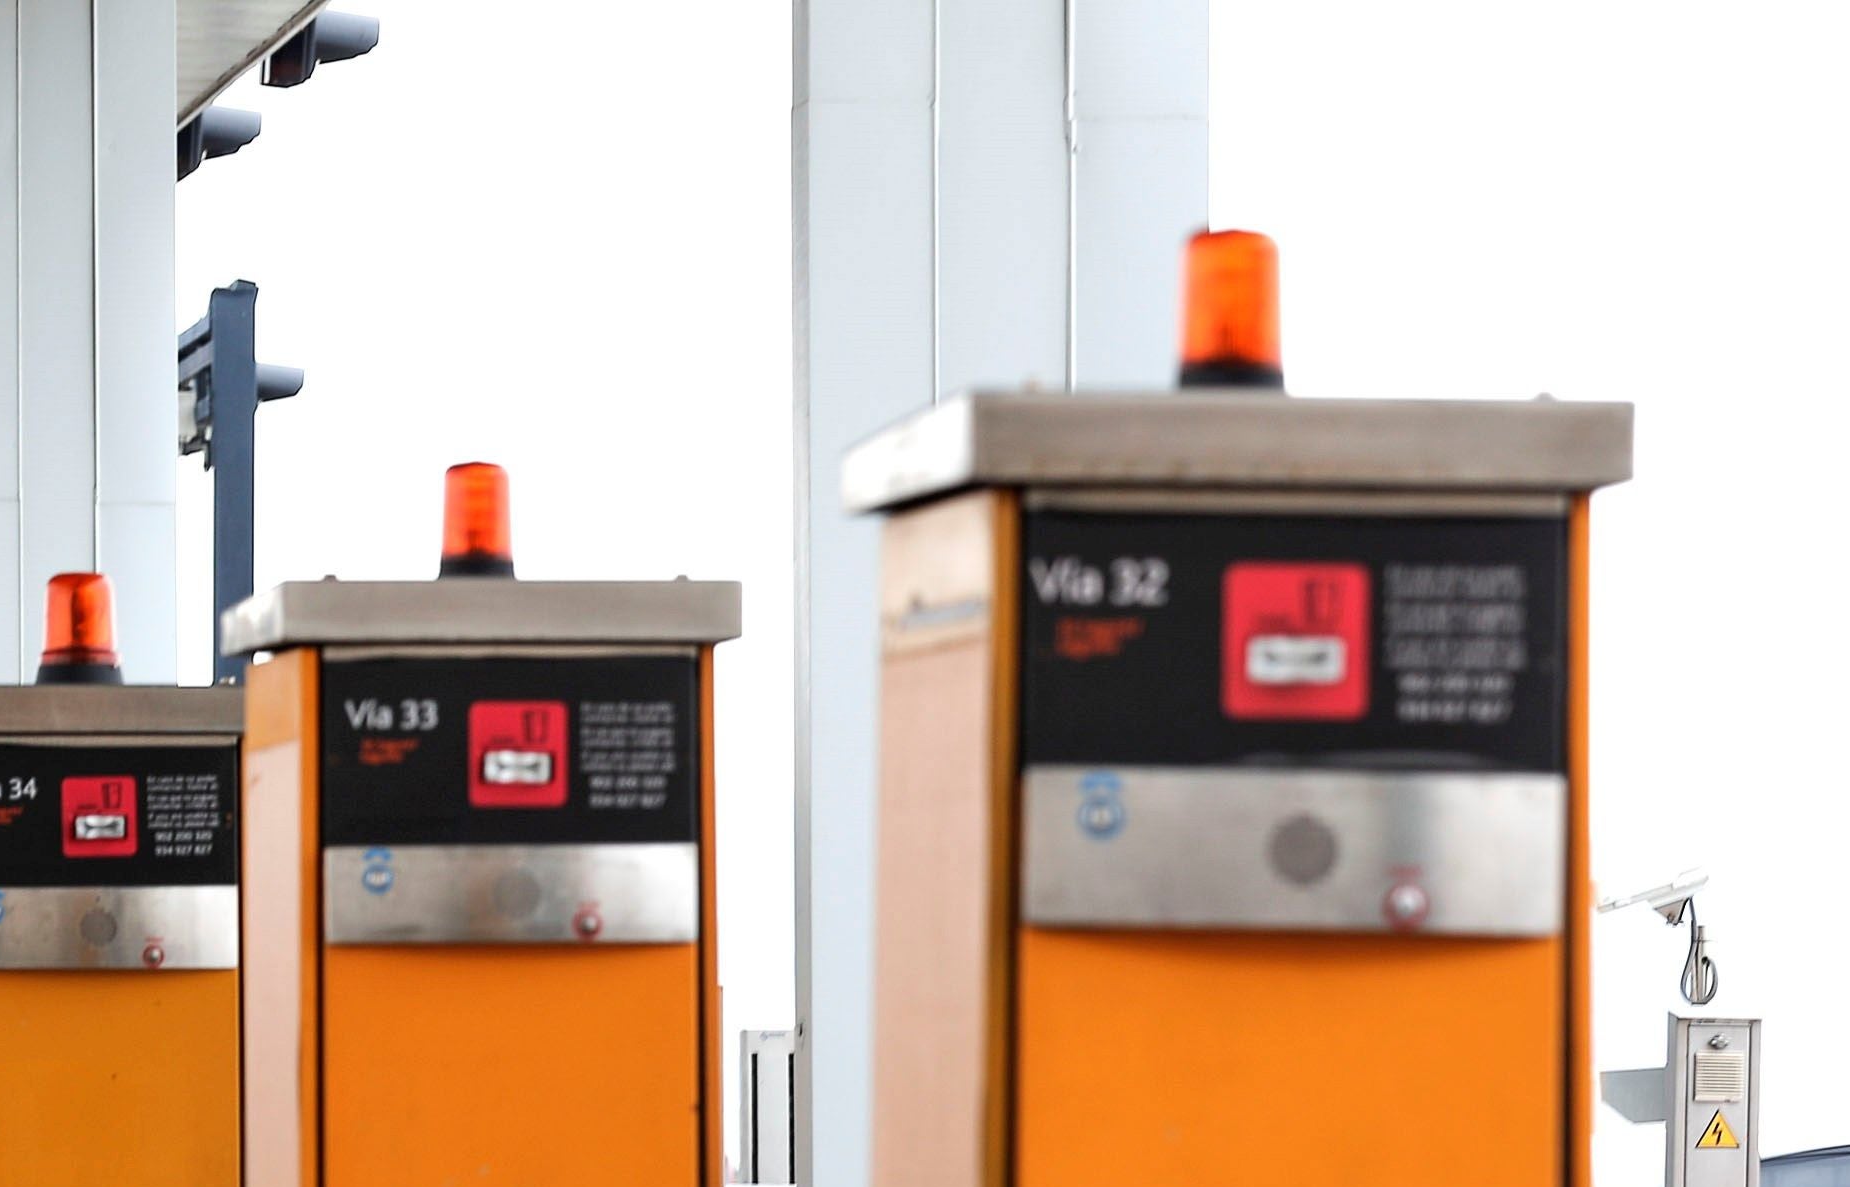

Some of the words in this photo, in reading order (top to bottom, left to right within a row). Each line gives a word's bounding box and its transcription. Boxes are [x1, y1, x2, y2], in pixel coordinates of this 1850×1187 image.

[1110, 559, 1169, 607] 32
[400, 700, 439, 731] 33
[8, 776, 38, 801] 34
